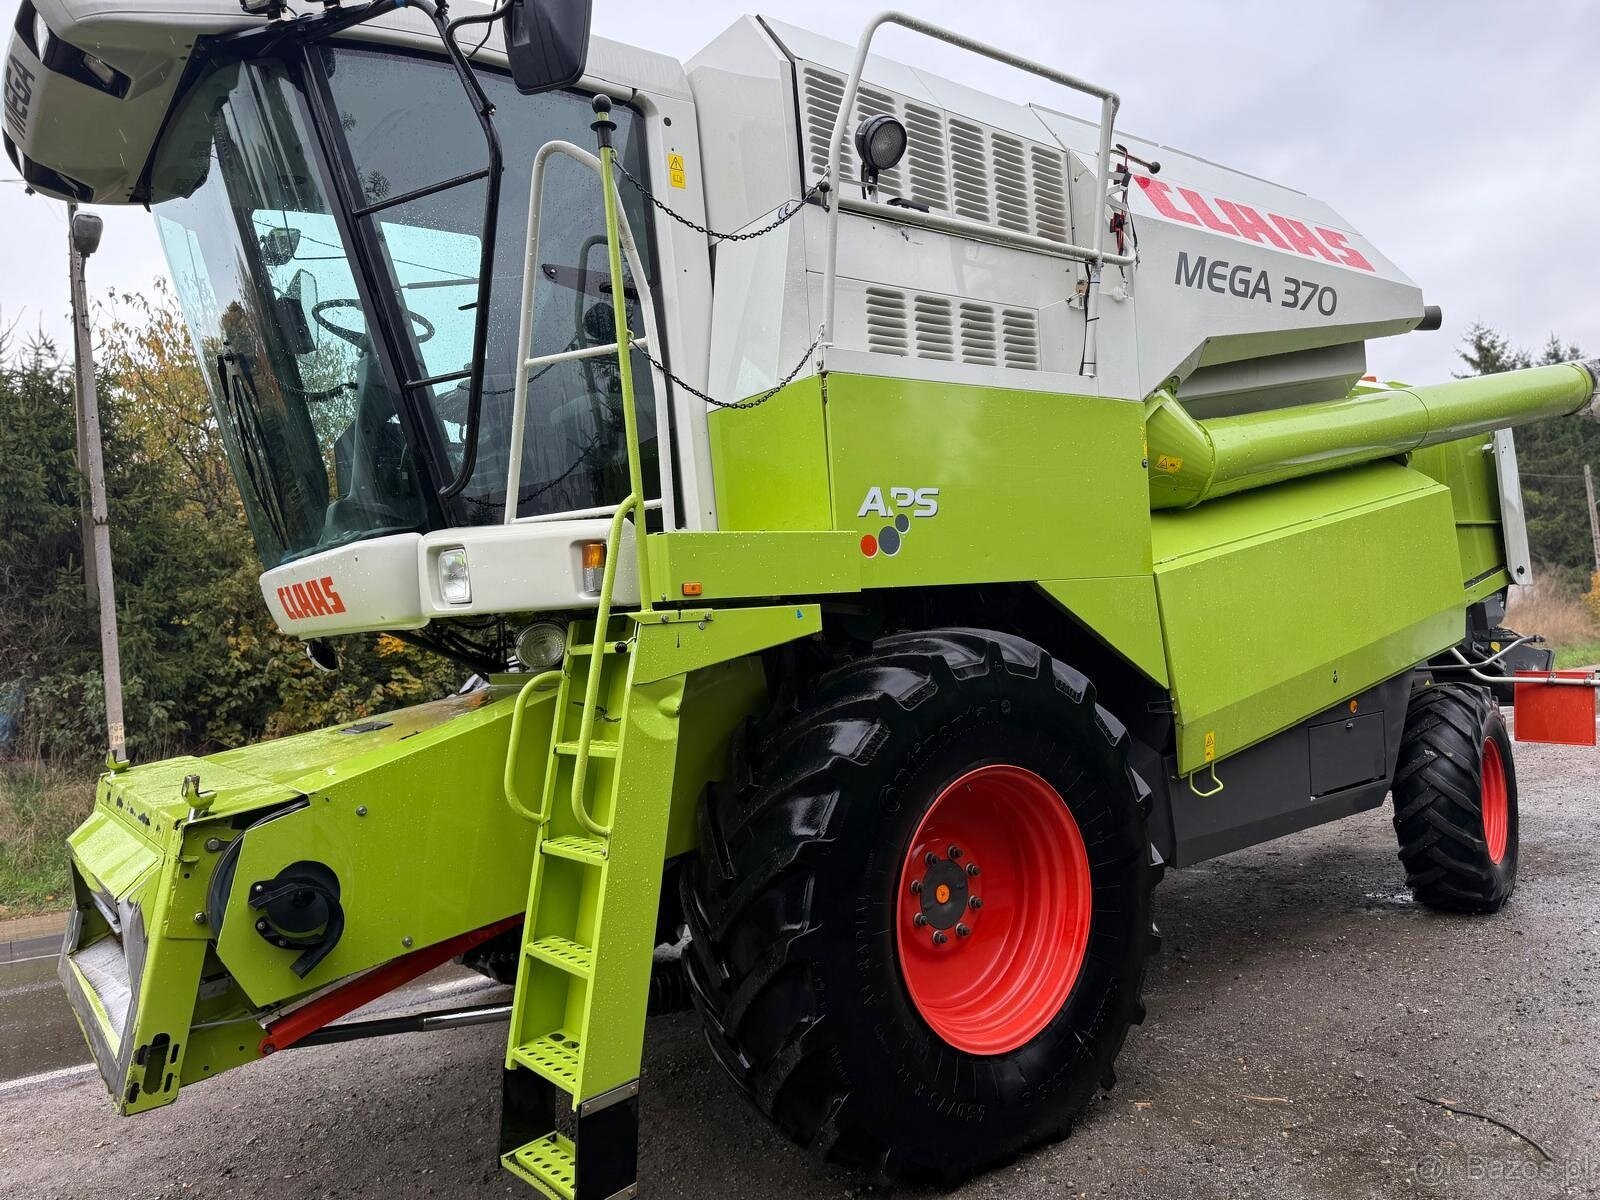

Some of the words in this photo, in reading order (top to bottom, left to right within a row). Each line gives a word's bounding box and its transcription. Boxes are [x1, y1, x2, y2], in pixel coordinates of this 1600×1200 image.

[4, 54, 35, 140] MEGA
[1132, 174, 1376, 273] CLAAS
[1174, 251, 1272, 304] MEGA
[1281, 276, 1338, 316] 370
[857, 486, 939, 517] APS
[277, 575, 346, 620] CLAAS
